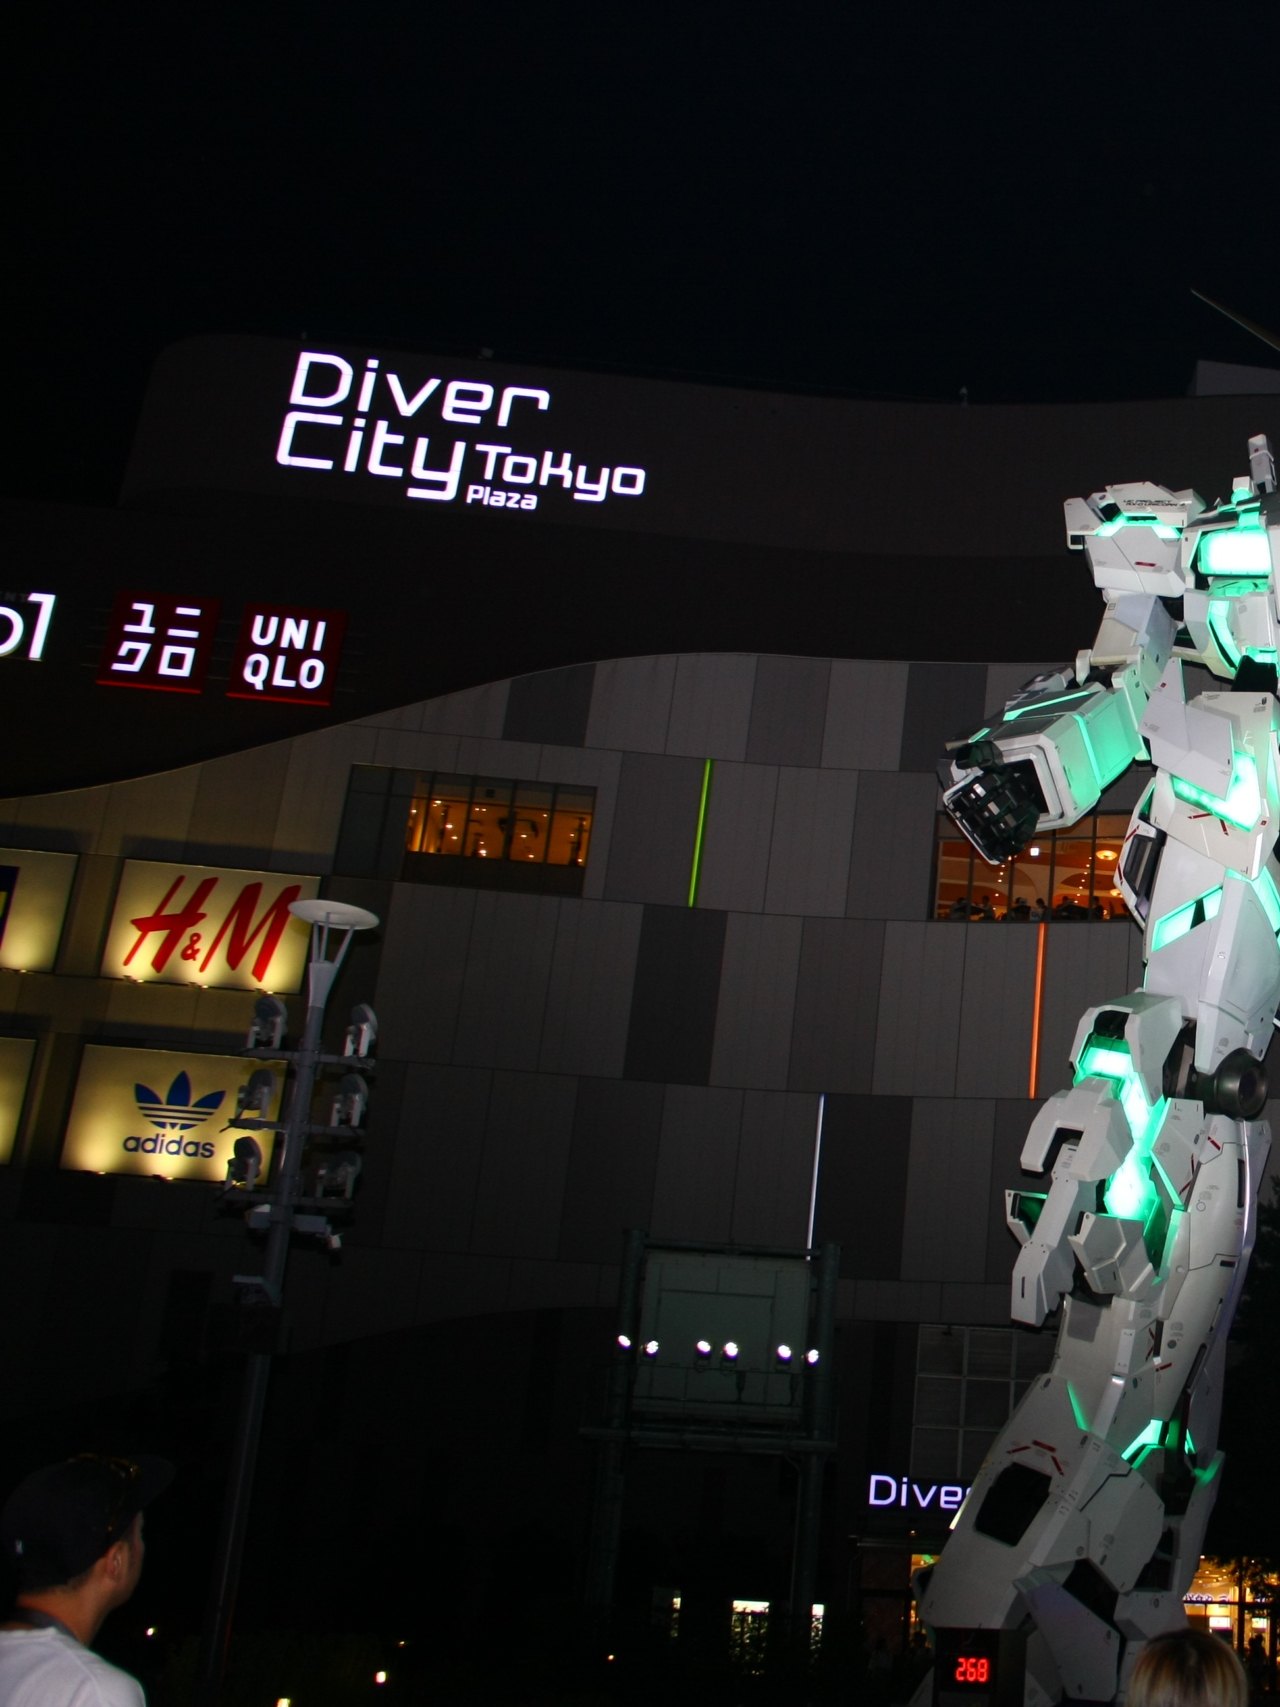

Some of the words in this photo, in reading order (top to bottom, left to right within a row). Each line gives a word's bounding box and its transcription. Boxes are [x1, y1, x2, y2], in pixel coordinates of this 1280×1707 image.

[289, 351, 551, 427] Diver
[276, 411, 467, 500] City
[475, 443, 646, 502] Tokyo
[466, 484, 538, 510] Plaza
[251, 614, 327, 651] UNI
[243, 653, 325, 690] QLO
[124, 875, 302, 982] H&M
[123, 1132, 215, 1158] adidas
[868, 1474, 971, 1510] Dive
[955, 1657, 990, 1683] 268
